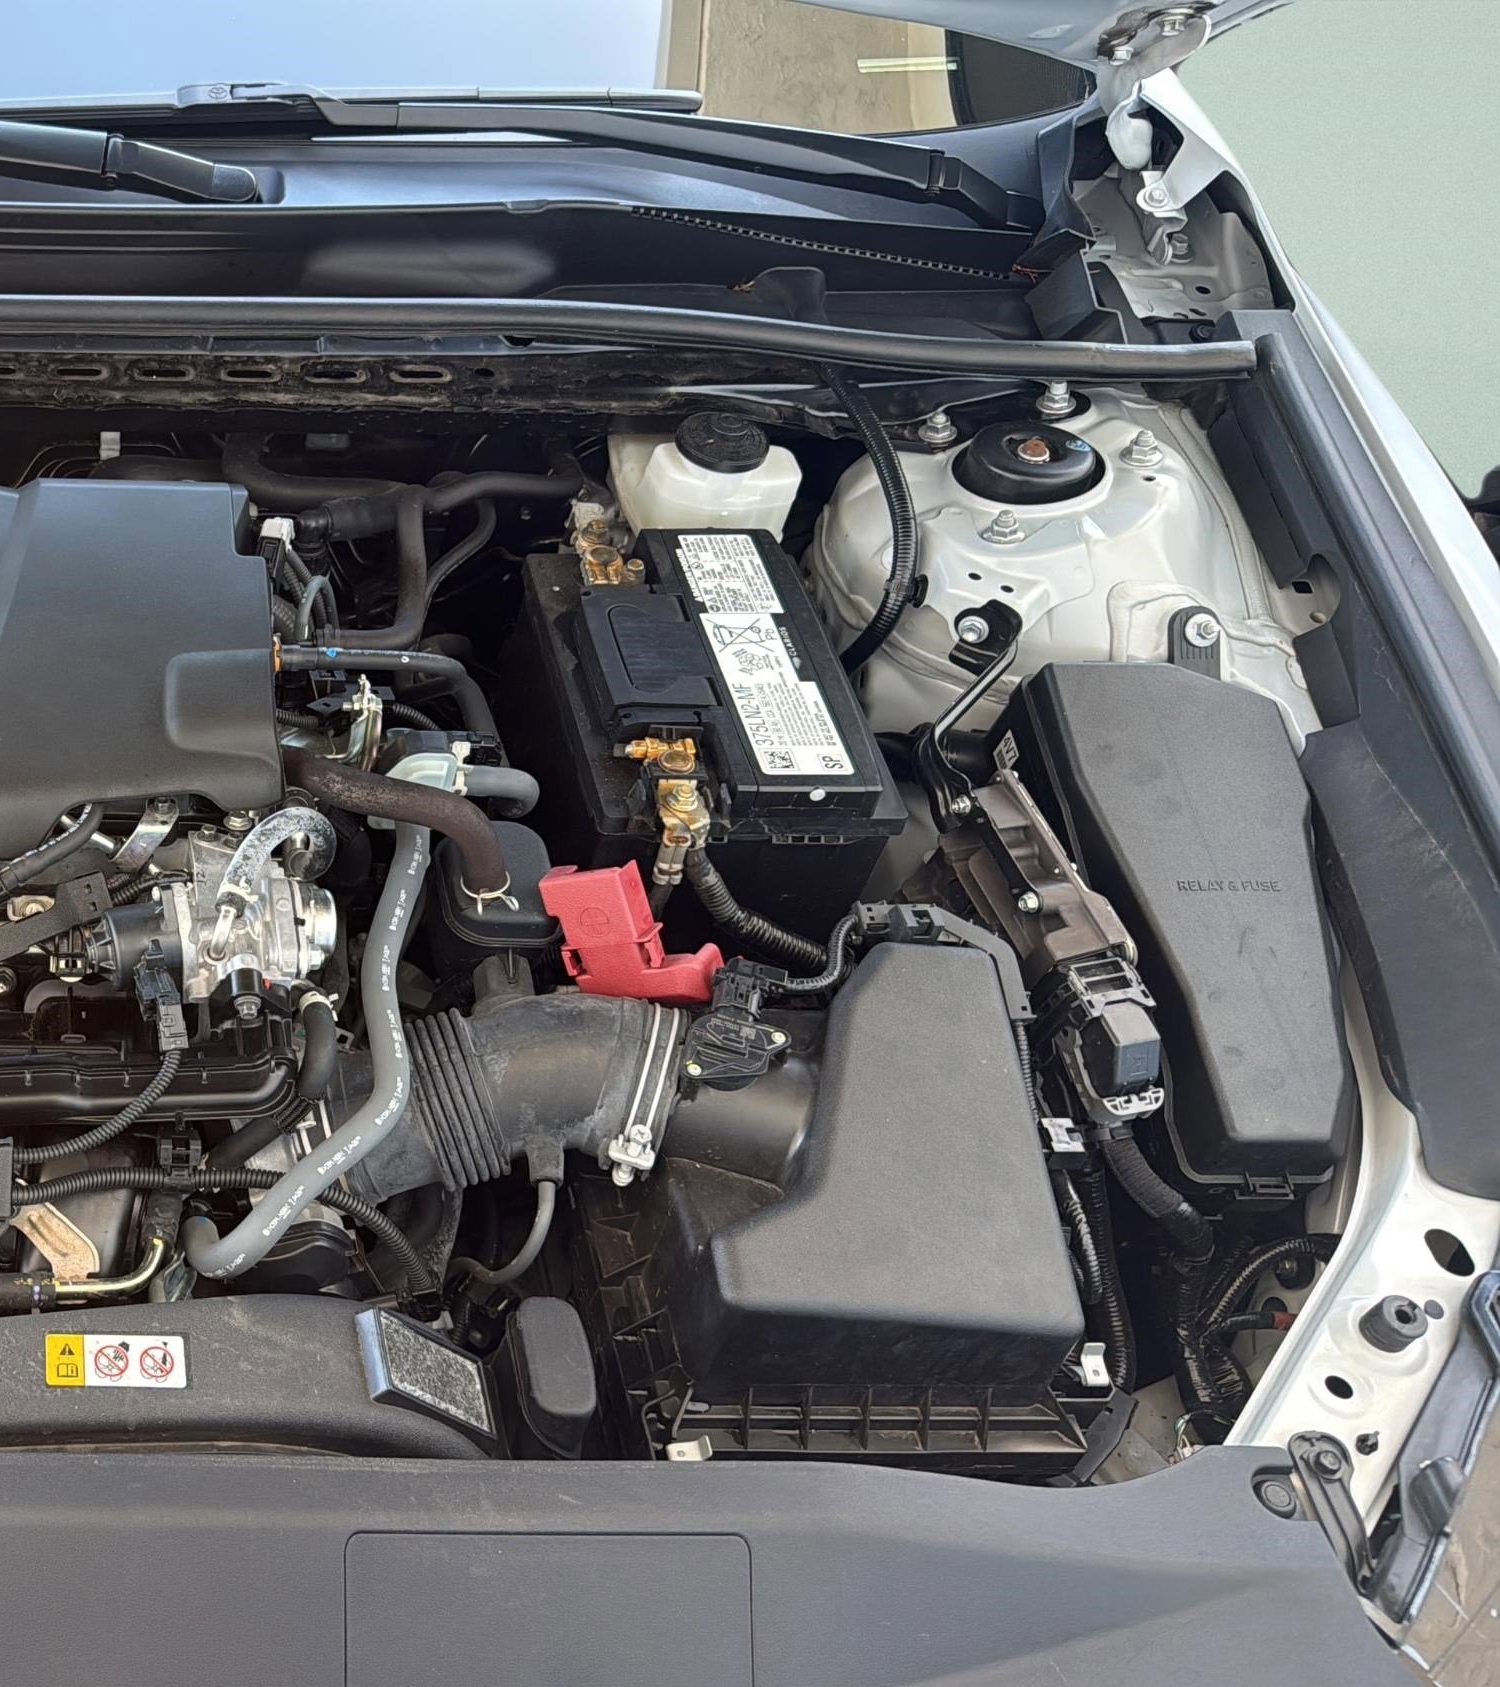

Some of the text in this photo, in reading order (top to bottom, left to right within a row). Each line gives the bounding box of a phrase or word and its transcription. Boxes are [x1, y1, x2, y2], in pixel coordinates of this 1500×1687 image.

[764, 628, 777, 640] Pb
[779, 626, 797, 656] CLARIOS
[731, 682, 774, 746] 375LN2-MF
[821, 755, 844, 769] SP
[1176, 880, 1281, 892] RELAY & FUSE
